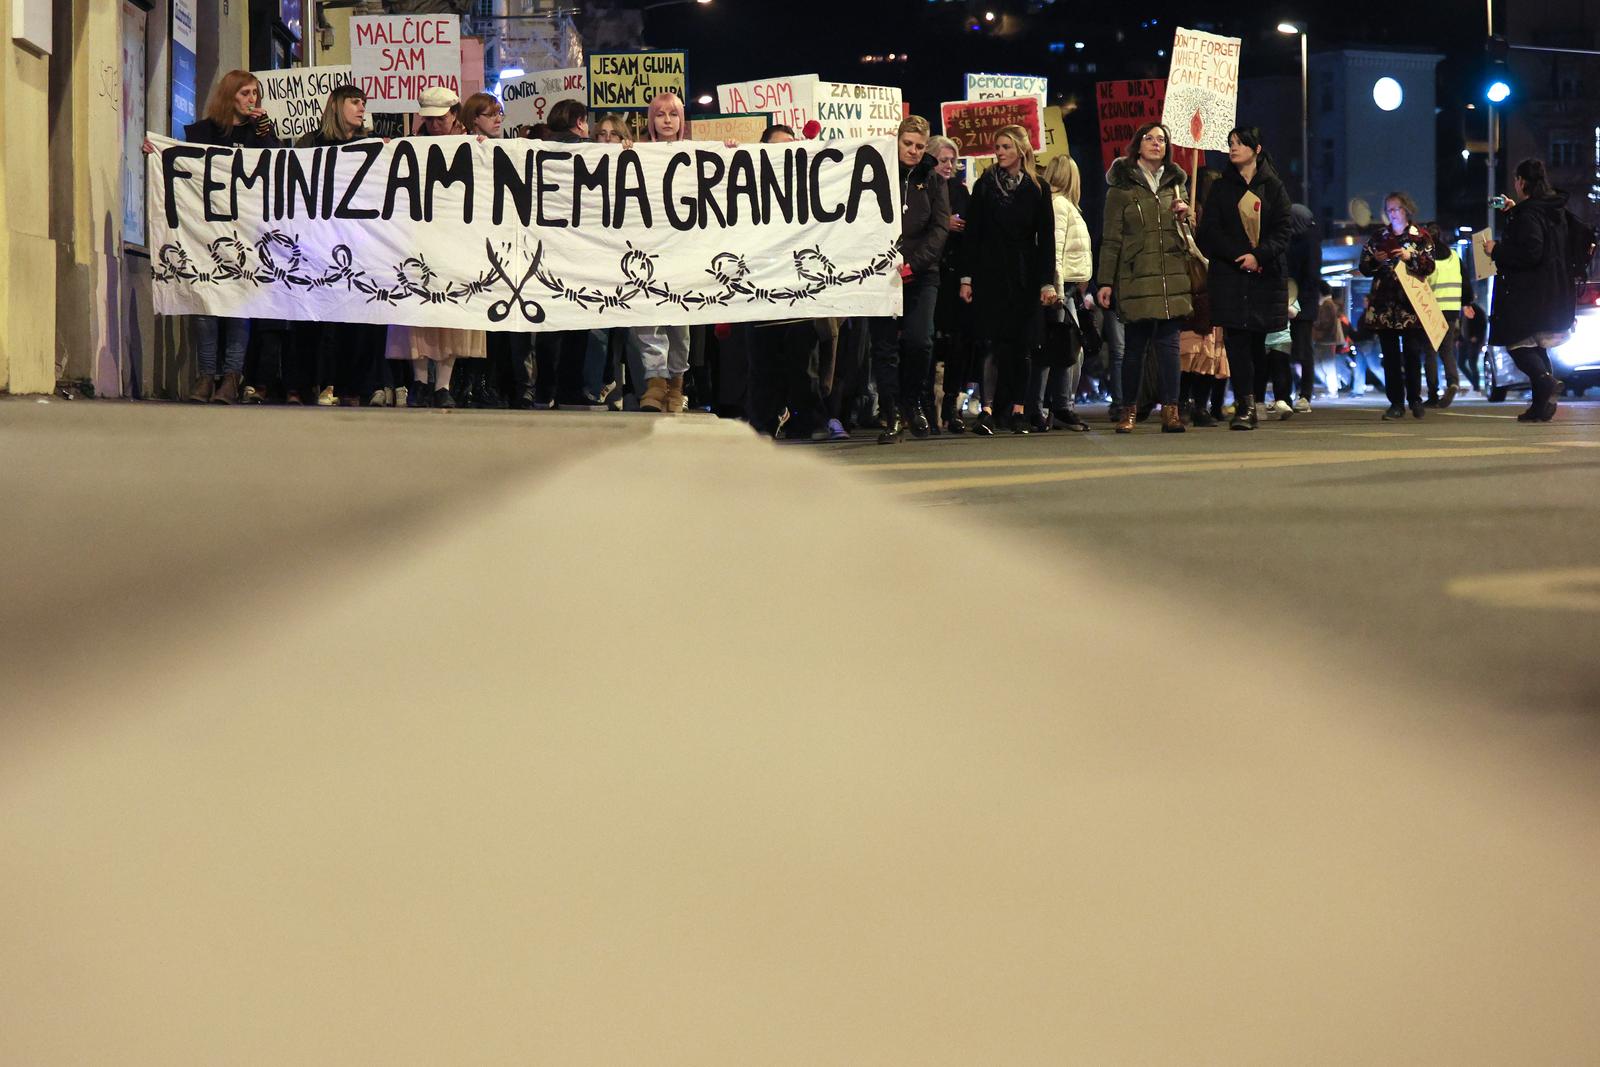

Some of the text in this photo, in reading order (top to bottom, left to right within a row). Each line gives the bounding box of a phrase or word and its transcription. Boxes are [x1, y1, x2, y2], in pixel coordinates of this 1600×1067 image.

[356, 17, 451, 46] MALČICE
[1174, 34, 1240, 57] DON'T FORGET
[379, 47, 425, 71] SAM
[593, 56, 639, 75] JESAM
[1175, 50, 1237, 81] WHERE YOU
[267, 74, 305, 100] NISAM
[307, 71, 352, 96] SIGURN
[502, 81, 539, 101] CONTROL
[631, 73, 650, 86] ALI
[1171, 68, 1235, 97] CAME FROM
[593, 80, 636, 105] NISAM
[726, 82, 793, 113] JA SAM
[831, 84, 895, 105] ZA OBITELJ
[286, 98, 323, 117] DOMA
[818, 102, 862, 120] KAKVU
[162, 140, 475, 229] FEMINIZAM
[491, 144, 653, 229] NEMA
[662, 143, 894, 232] GRANICA
